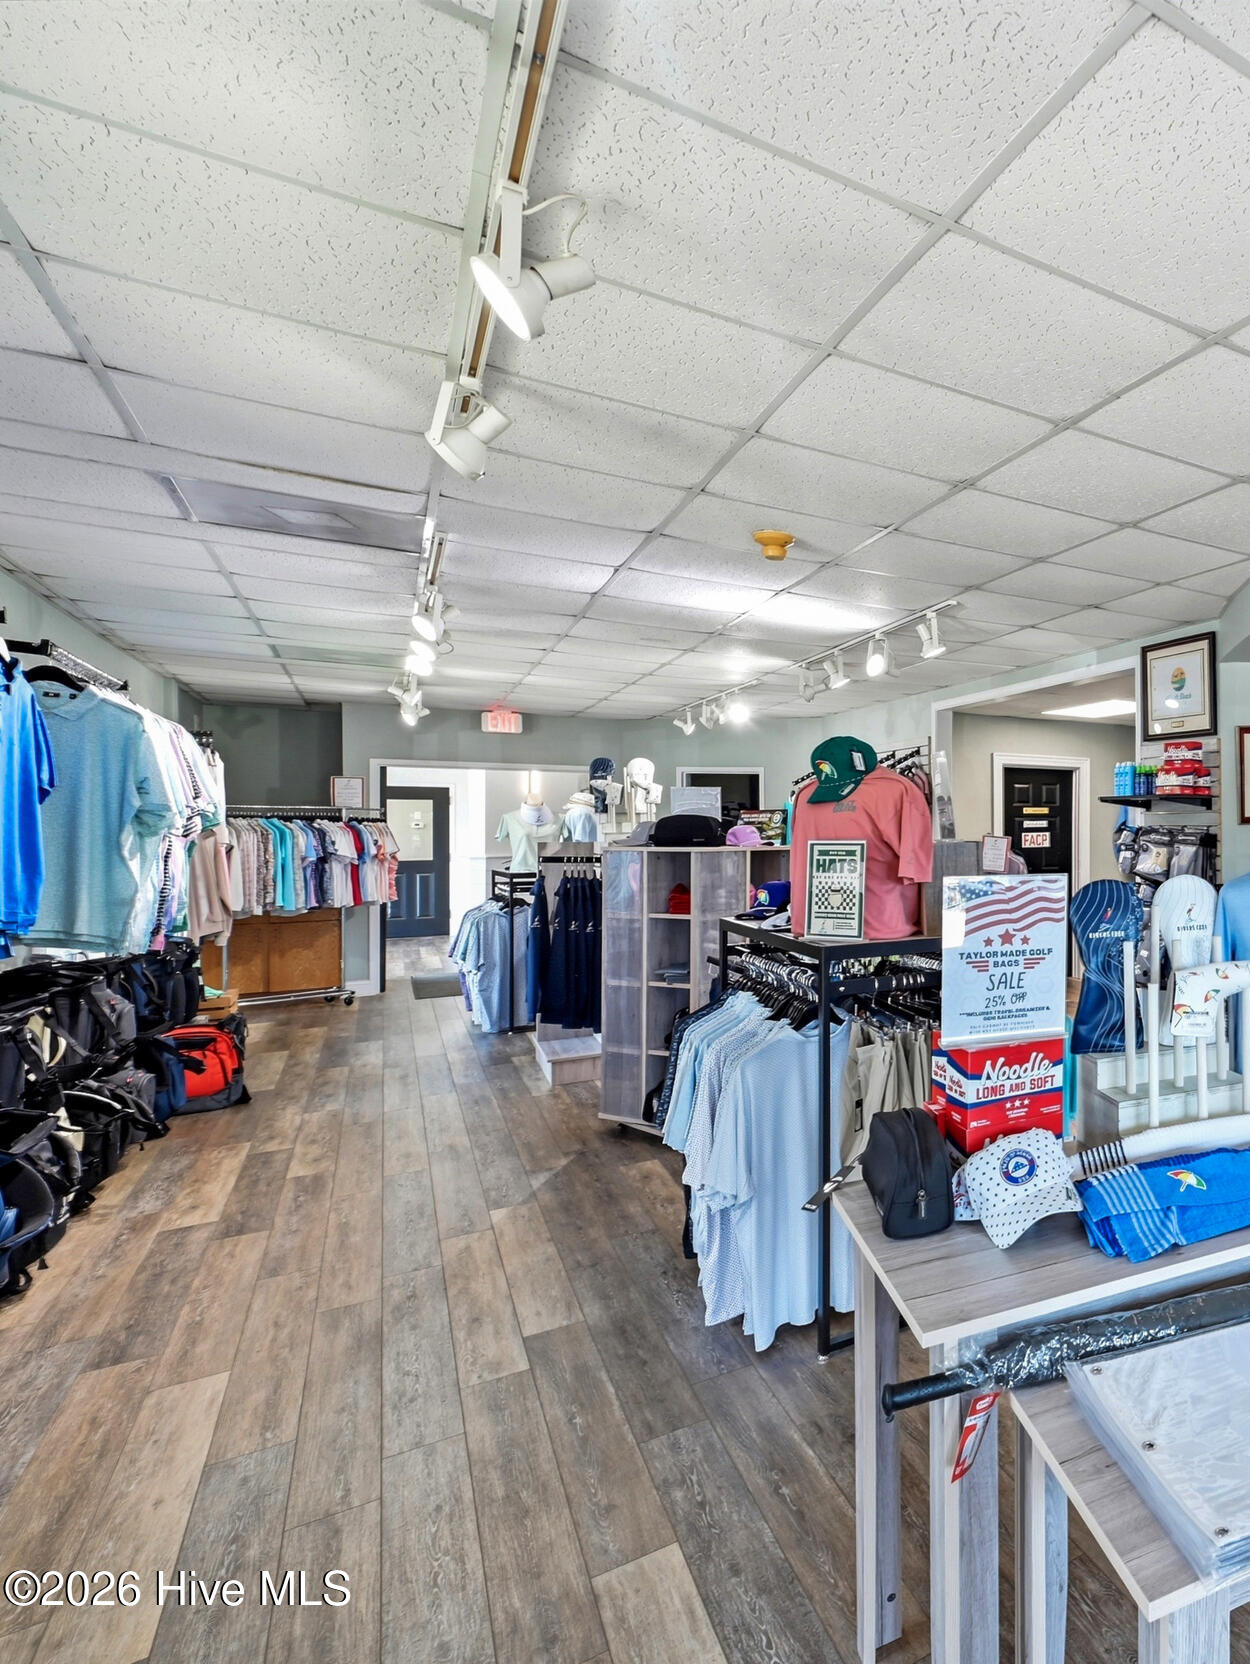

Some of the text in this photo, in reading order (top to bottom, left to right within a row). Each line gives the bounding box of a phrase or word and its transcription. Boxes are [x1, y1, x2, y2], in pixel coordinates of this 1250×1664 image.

[1023, 833, 1048, 847] FACP
[815, 858, 858, 874] HATS
[958, 947, 1053, 961] TAYLOR MADE GOLF
[992, 959, 1020, 969] BAGS
[985, 971, 1027, 992] SALE
[984, 991, 1027, 1009] 25% OFF
[980, 1051, 1053, 1087] Noodle
[975, 1084, 1005, 1100] LONG
[1008, 1081, 1026, 1094] AND
[1029, 1074, 1056, 1091] SOFT
